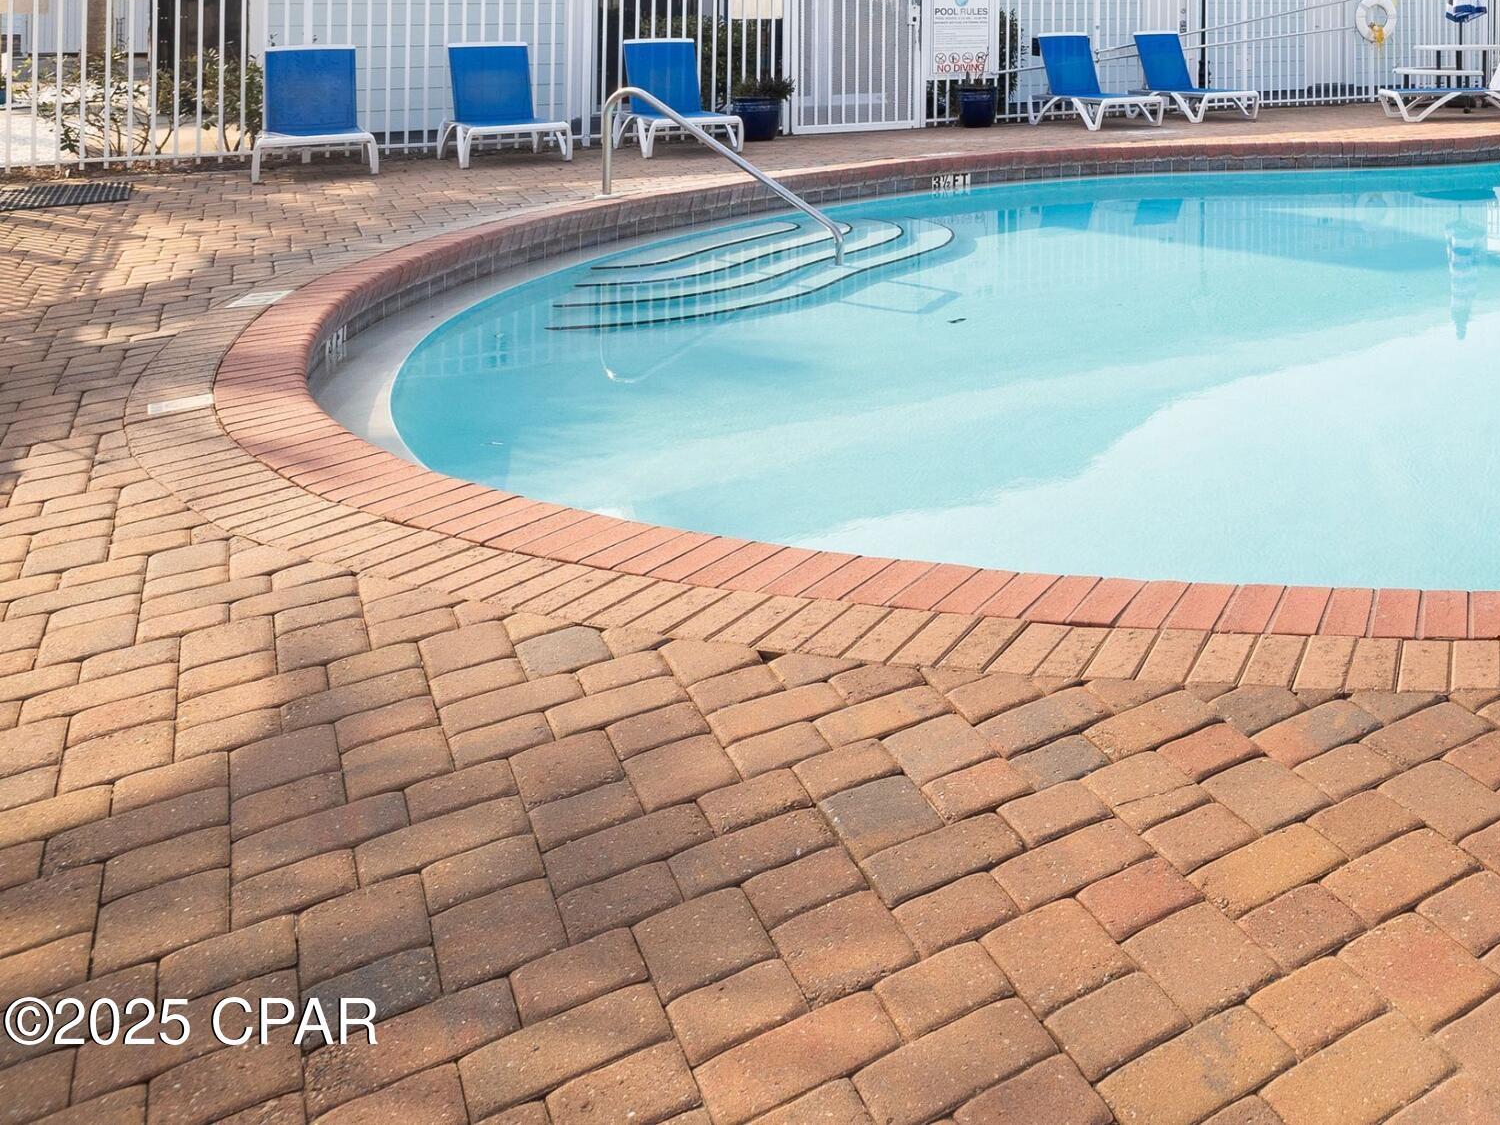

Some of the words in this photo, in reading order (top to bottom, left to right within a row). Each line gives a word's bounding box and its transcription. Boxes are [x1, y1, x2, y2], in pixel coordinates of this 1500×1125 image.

[934, 7, 958, 16] POOL
[960, 7, 988, 16] RULES
[936, 64, 951, 73] NO
[953, 63, 985, 72] DIVING
